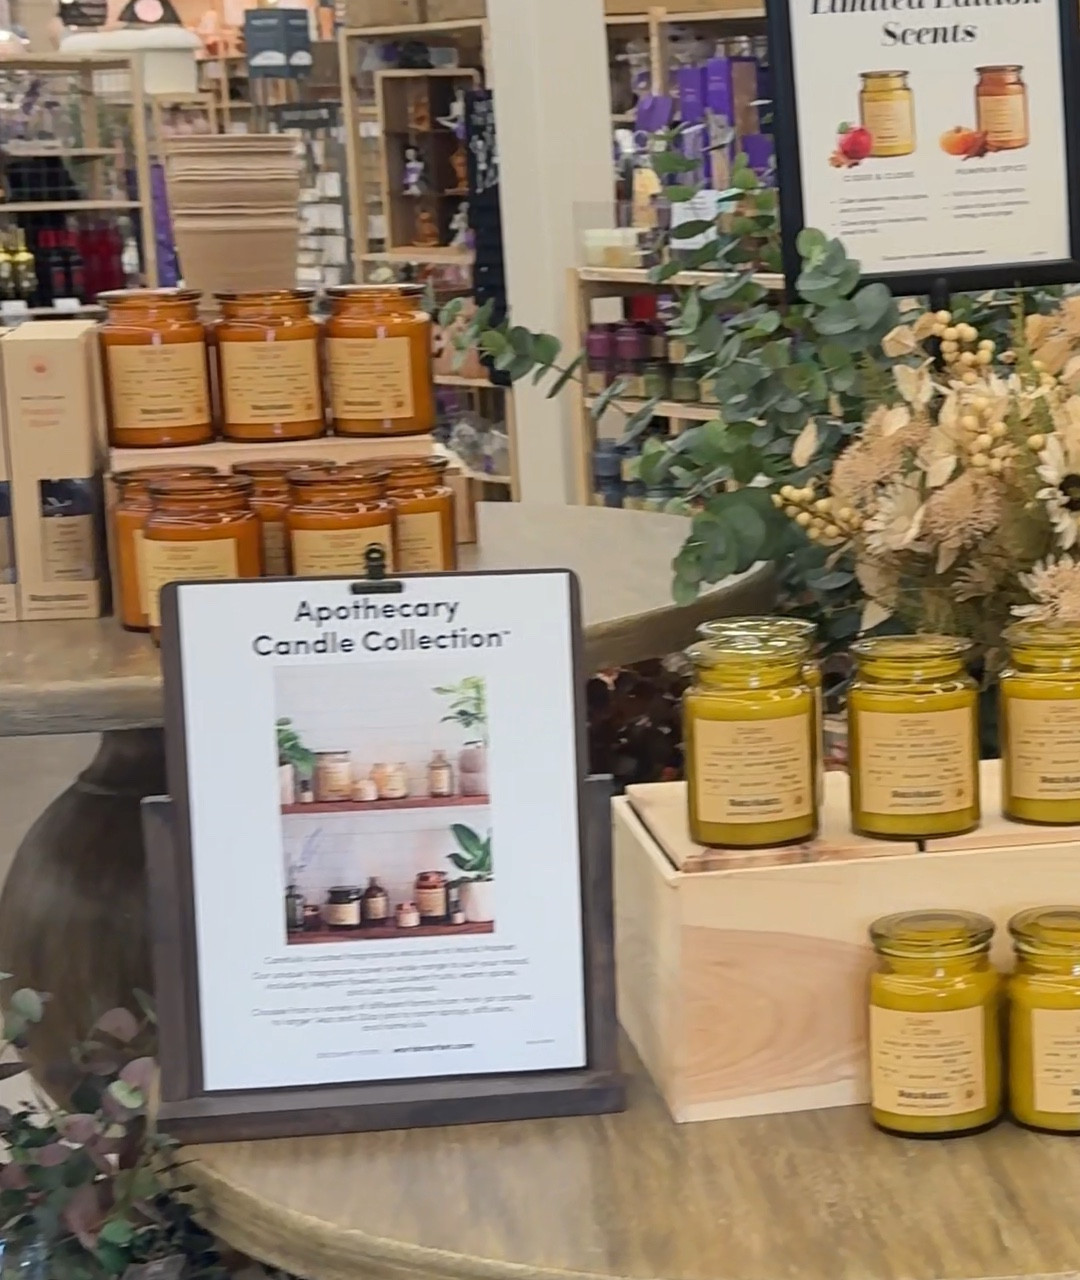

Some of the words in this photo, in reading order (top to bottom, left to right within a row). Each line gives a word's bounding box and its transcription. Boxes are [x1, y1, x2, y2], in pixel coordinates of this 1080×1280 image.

[881, 21, 979, 47] Scents
[294, 598, 460, 628] Apothecary
[253, 631, 355, 656] Candle
